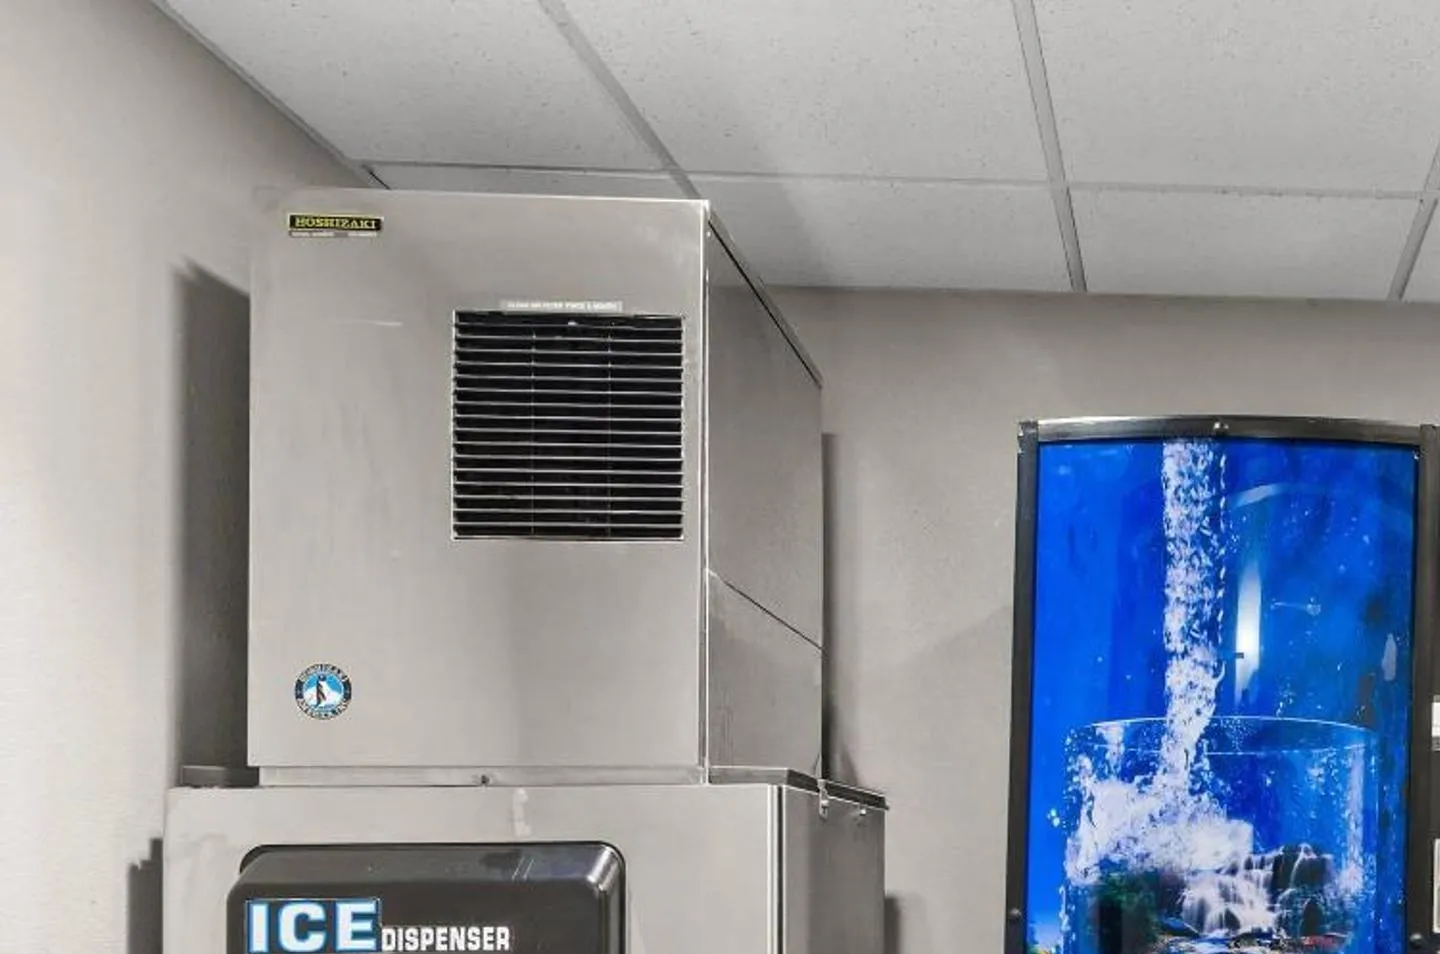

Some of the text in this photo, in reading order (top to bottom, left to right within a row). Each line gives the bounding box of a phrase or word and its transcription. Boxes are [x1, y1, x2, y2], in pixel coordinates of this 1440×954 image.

[294, 216, 377, 230] HOSHIZAKI
[250, 900, 511, 954] ICE DISPENSER
